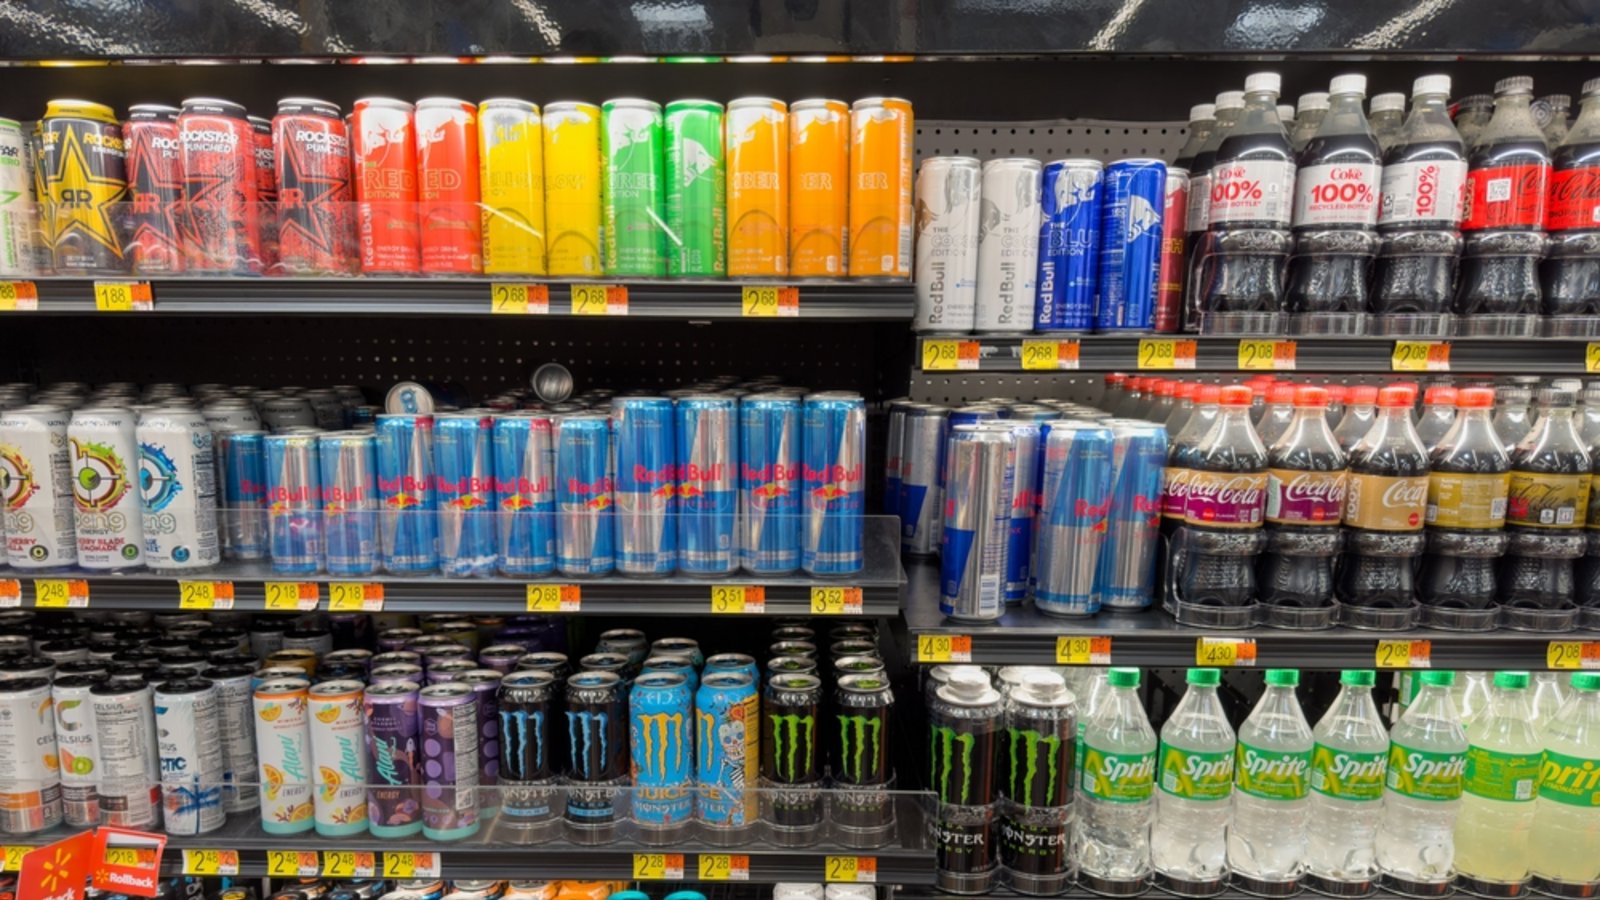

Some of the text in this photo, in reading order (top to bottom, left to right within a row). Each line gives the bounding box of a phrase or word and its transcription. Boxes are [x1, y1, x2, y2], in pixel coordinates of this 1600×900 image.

[1330, 168, 1363, 180] Coke
[1311, 184, 1374, 204] 100%
[1416, 166, 1434, 216] 100%
[930, 262, 945, 324] Red Bull
[999, 262, 1016, 324] Red Bull
[1040, 262, 1055, 324] Red Bull
[688, 463, 721, 482] Bull
[832, 464, 863, 483] Bull
[278, 486, 308, 502] Bull
[333, 486, 363, 502] Bull
[1242, 750, 1306, 778] Sprite
[638, 783, 689, 800] JUICE
[110, 872, 154, 889] Rollback
